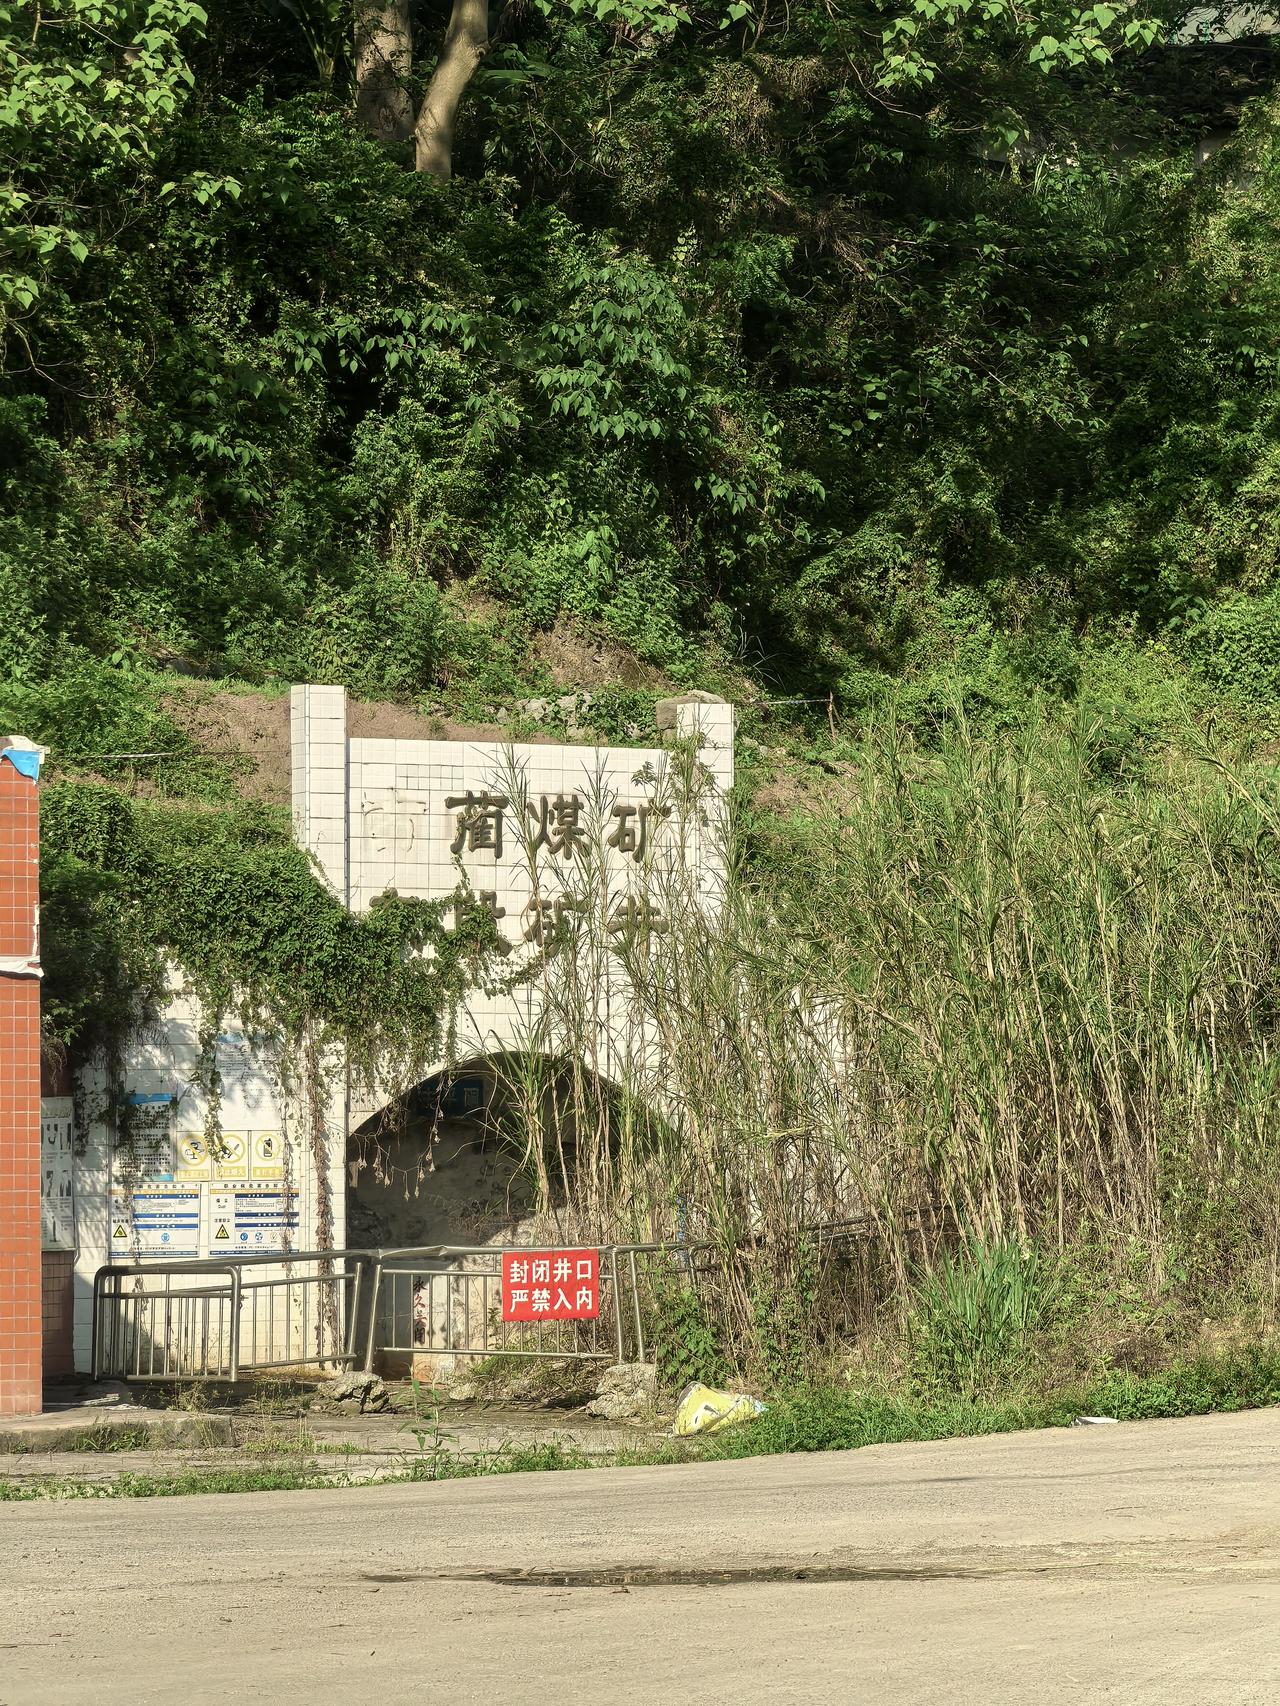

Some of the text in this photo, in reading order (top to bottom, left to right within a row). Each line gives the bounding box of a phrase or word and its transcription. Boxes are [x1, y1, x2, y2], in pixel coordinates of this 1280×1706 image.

[510, 1258, 592, 1284] 封闭井口
[510, 1286, 593, 1312] 严禁入内
